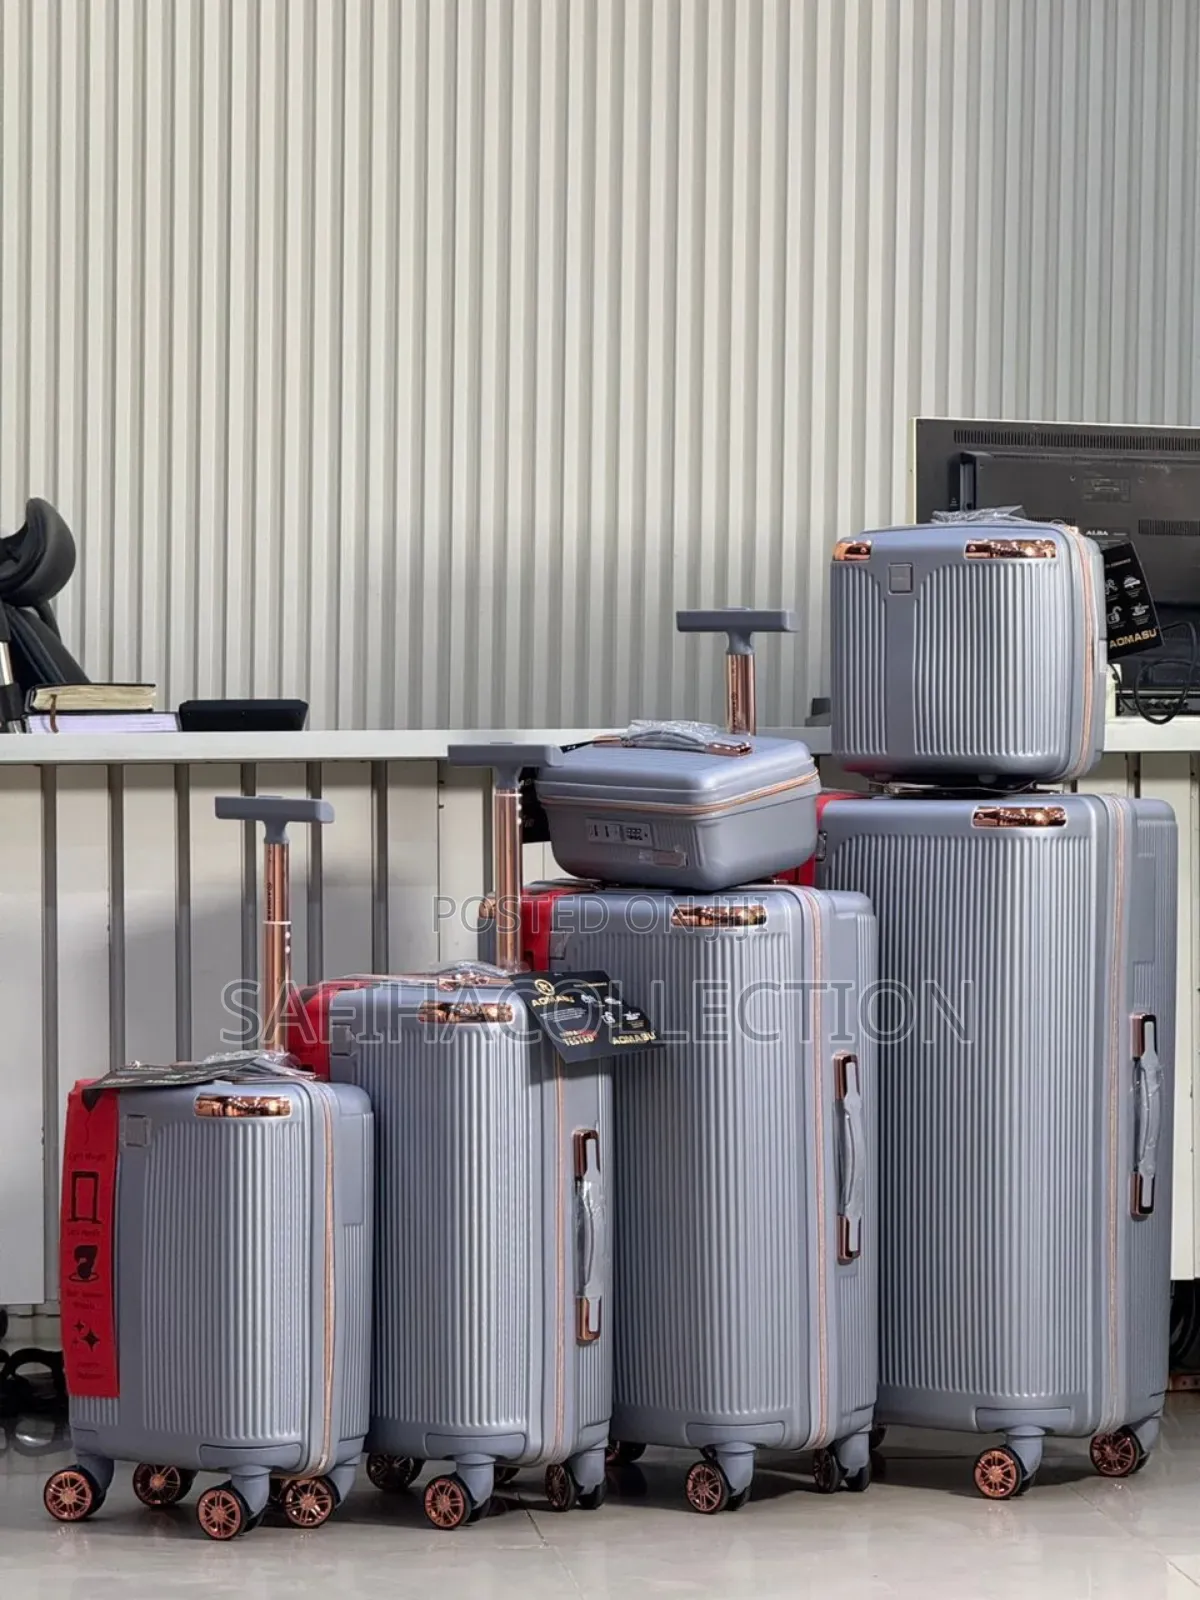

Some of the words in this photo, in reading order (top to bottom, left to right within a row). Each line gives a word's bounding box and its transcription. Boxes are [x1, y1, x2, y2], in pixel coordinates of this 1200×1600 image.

[1109, 628, 1157, 649] AOMASU
[562, 1034, 595, 1047] TESTED
[611, 1031, 657, 1046] AOMASU
